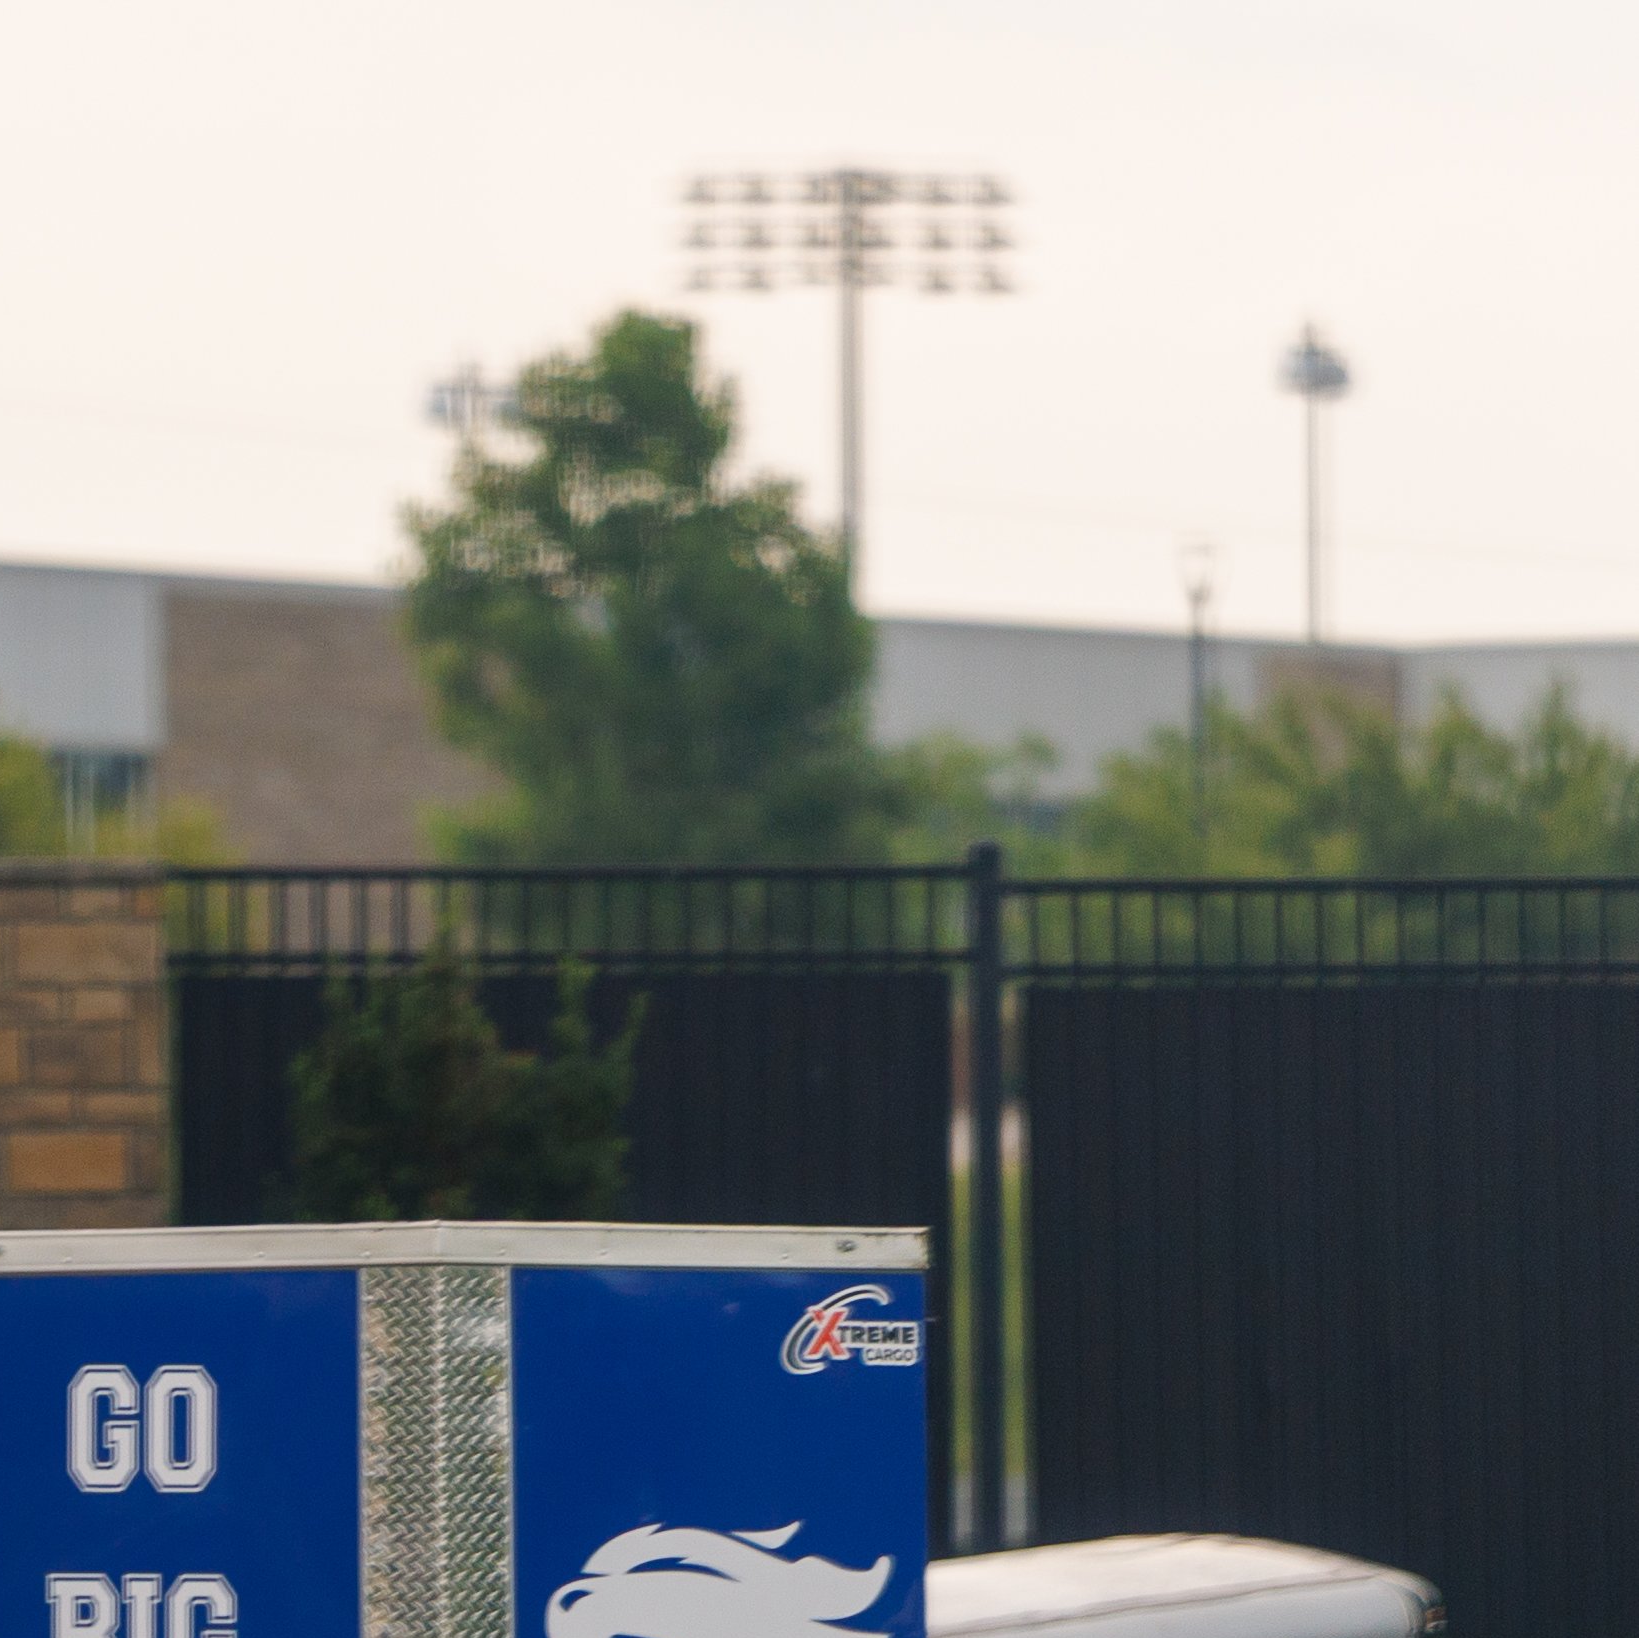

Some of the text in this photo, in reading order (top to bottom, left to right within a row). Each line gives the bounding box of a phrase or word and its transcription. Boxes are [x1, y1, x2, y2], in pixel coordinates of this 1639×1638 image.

[808, 1309, 916, 1357] XTREME
[866, 1348, 915, 1362] CARGO
[67, 1364, 218, 1492] GO
